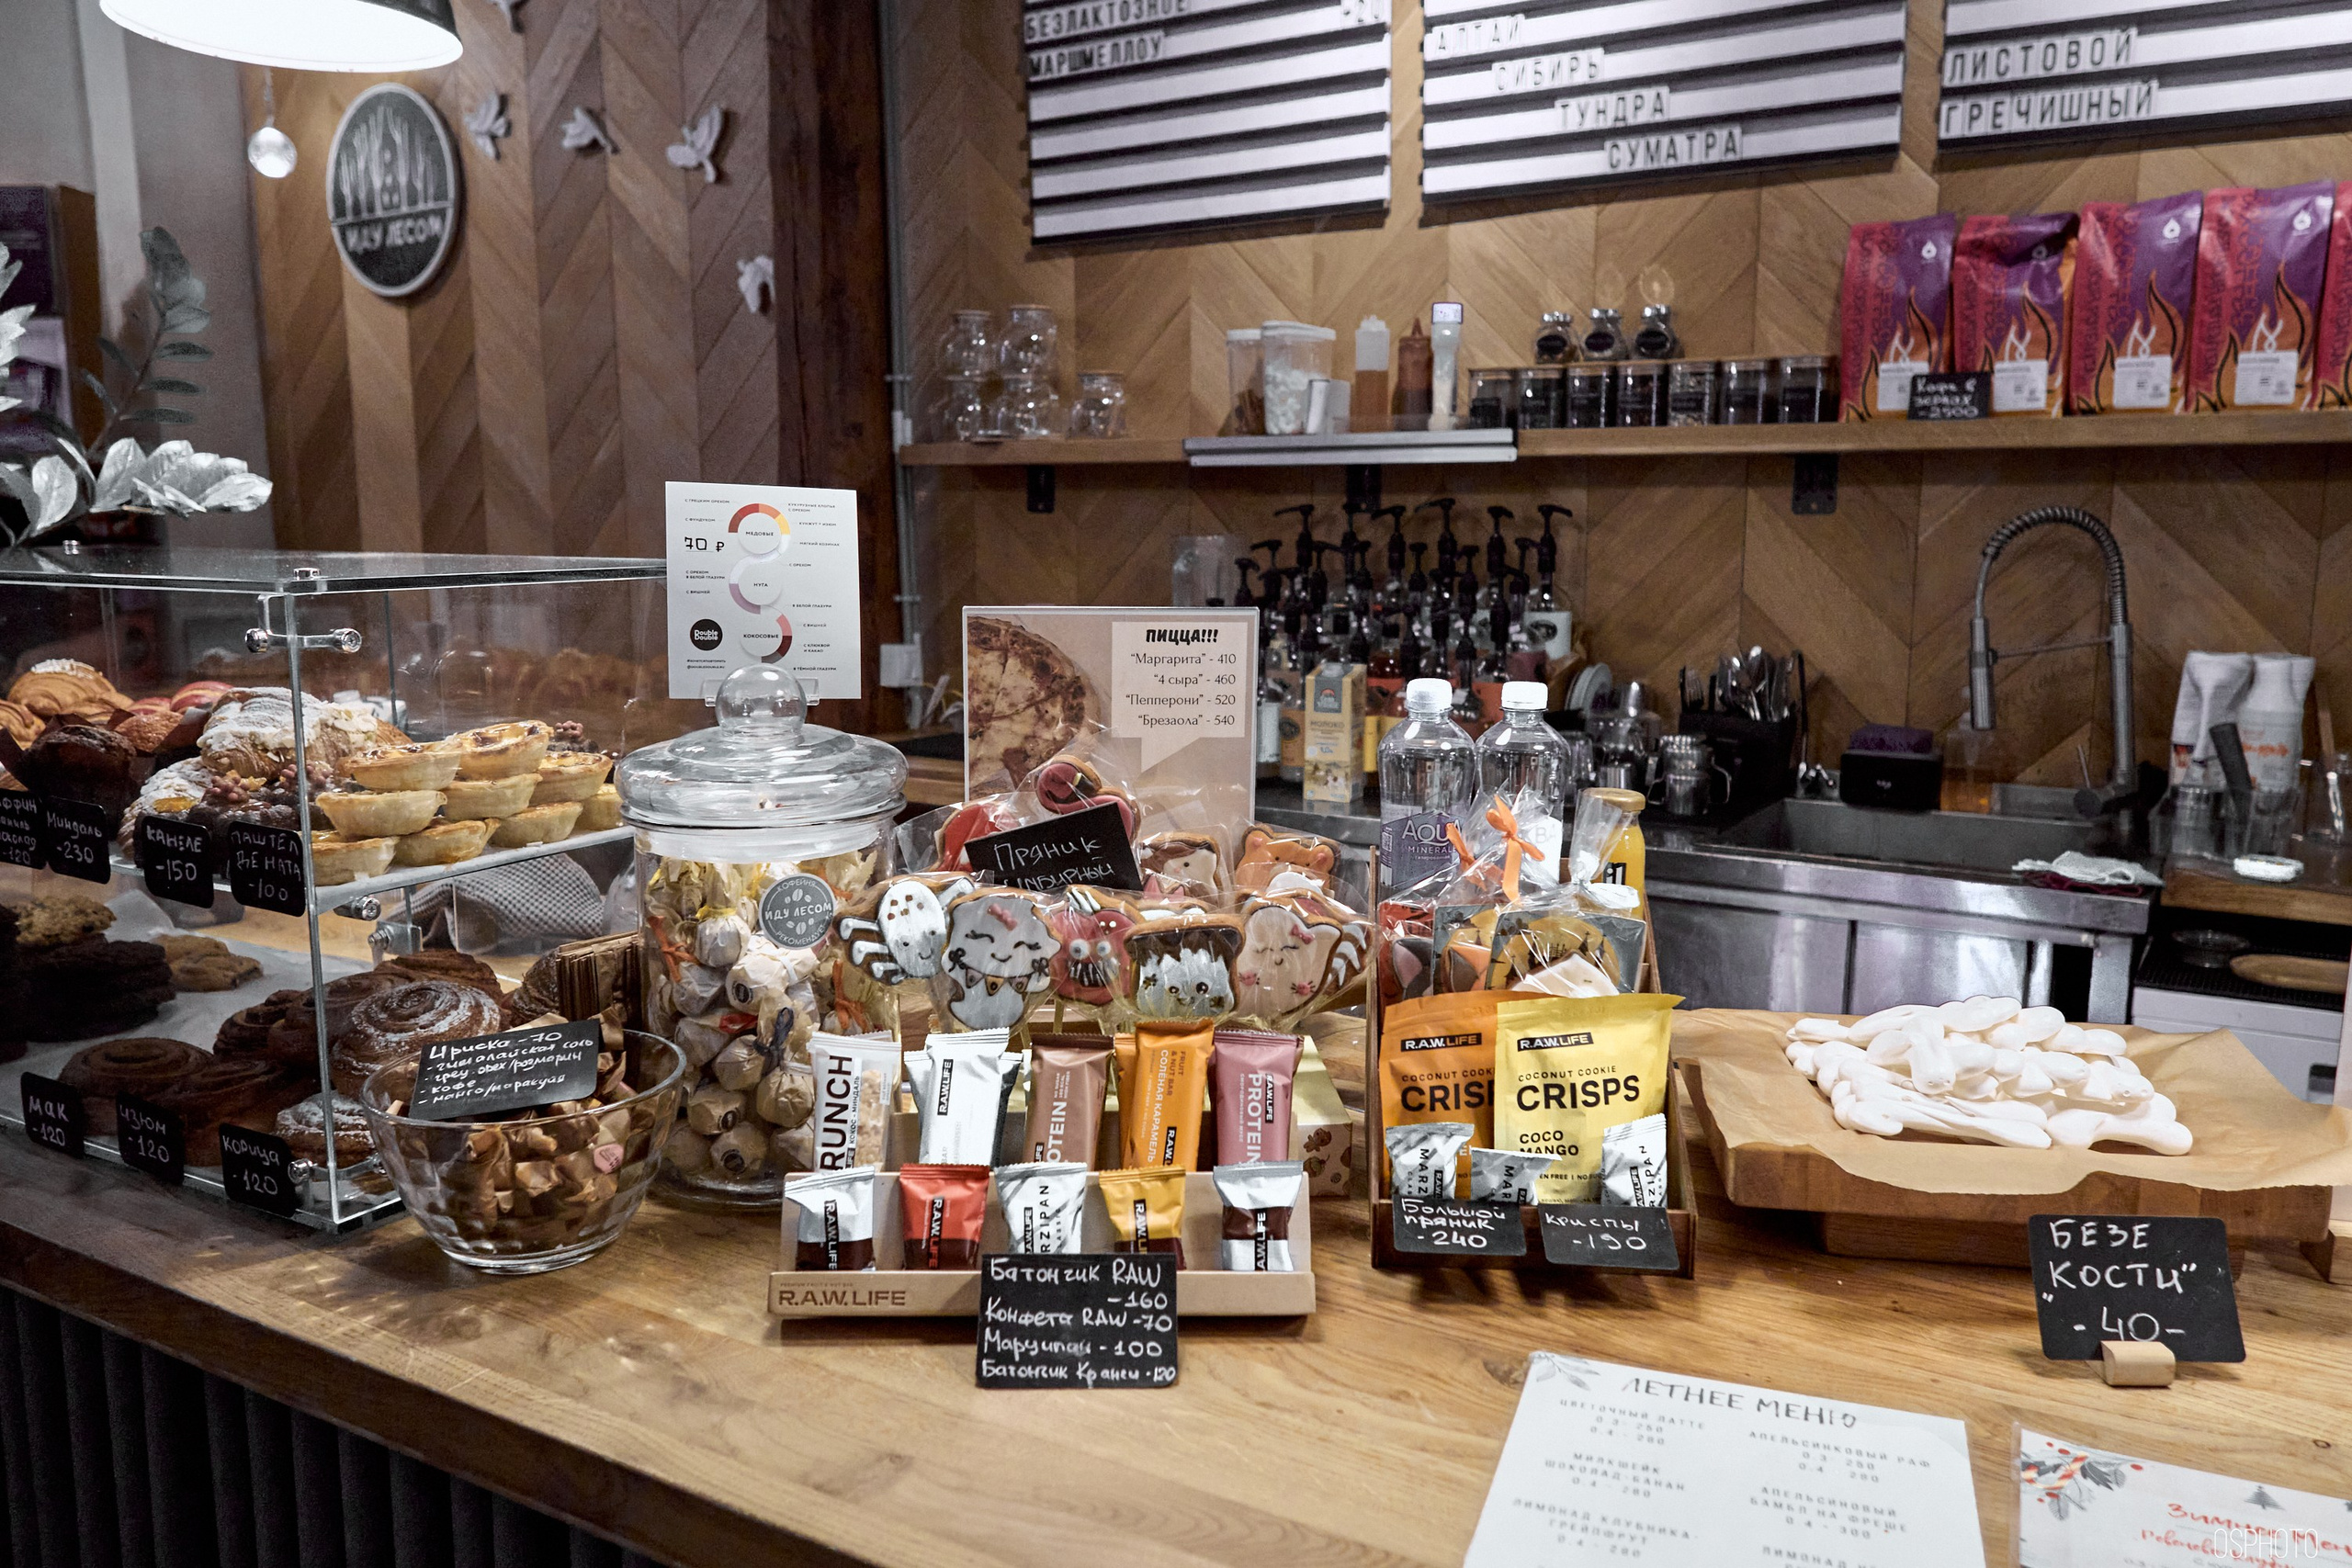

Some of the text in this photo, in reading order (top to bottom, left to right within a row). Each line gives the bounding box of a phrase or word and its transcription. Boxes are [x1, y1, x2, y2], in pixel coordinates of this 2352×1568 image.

[1030, 35, 1162, 76] МАРШМЕЛЛОУ
[1949, 27, 2132, 82] ЛИСТОВОЙ
[1496, 55, 1599, 91] СИБИРЬ
[1560, 91, 1665, 127] ТУНДРА
[1945, 80, 2153, 132] ГРЕЧИШНЫЙ
[1609, 130, 1738, 169] СУМАТРА
[684, 536, 707, 551] 70
[1146, 629, 1218, 645] ПИЦЦА!!!
[1217, 653, 1237, 664] 410
[1215, 674, 1237, 685] 460
[1215, 694, 1236, 705] 520
[1214, 715, 1235, 726] 540
[56, 841, 94, 863] -230
[155, 859, 198, 882] -150
[248, 878, 288, 901] -100
[764, 902, 832, 920] ИДУ ЛЕСОМ
[562, 1039, 594, 1049] соль
[1178, 1051, 1186, 1077] FRUIT
[1401, 1070, 1458, 1082] COCONUT
[1518, 1065, 1617, 1082] COCONUT COOKIE
[432, 1078, 477, 1094] кофе
[852, 1076, 860, 1113] МИНДАЛЬ
[1401, 1081, 1495, 1111] CRIS
[1517, 1075, 1640, 1111] CRISPS
[820, 1055, 853, 1171] RUNCH
[1148, 1049, 1170, 1163] СОЛЁНАЯ КАРАМЕЛЬ
[849, 1117, 858, 1144] КОКОС
[1046, 1101, 1068, 1163] OTEIN
[1247, 1074, 1262, 1165] PROTEIN
[32, 1123, 65, 1147] -120
[1520, 1130, 1564, 1145] COCO
[128, 1135, 170, 1163] -120
[232, 1170, 278, 1195] -120
[1418, 1148, 1430, 1194] MARZ
[1638, 1145, 1655, 1207] RZIPAN
[1039, 1185, 1051, 1253] RZIPAN
[1401, 1198, 1505, 1220] Большой
[1417, 1231, 1487, 1248] -240
[1573, 1234, 1647, 1250] -190
[2049, 1219, 2151, 1249] БЕЗЕ
[990, 1258, 1161, 1287] Батончик RAW
[985, 1296, 1073, 1327] Конфета
[1082, 1307, 1127, 1327] RAW
[1107, 1292, 1168, 1310] -160
[984, 1327, 1091, 1361] Марципан
[982, 1359, 1068, 1379] Батончик
[1621, 1378, 1857, 1428] ЛЕТНЕЕ МЕНЮ
